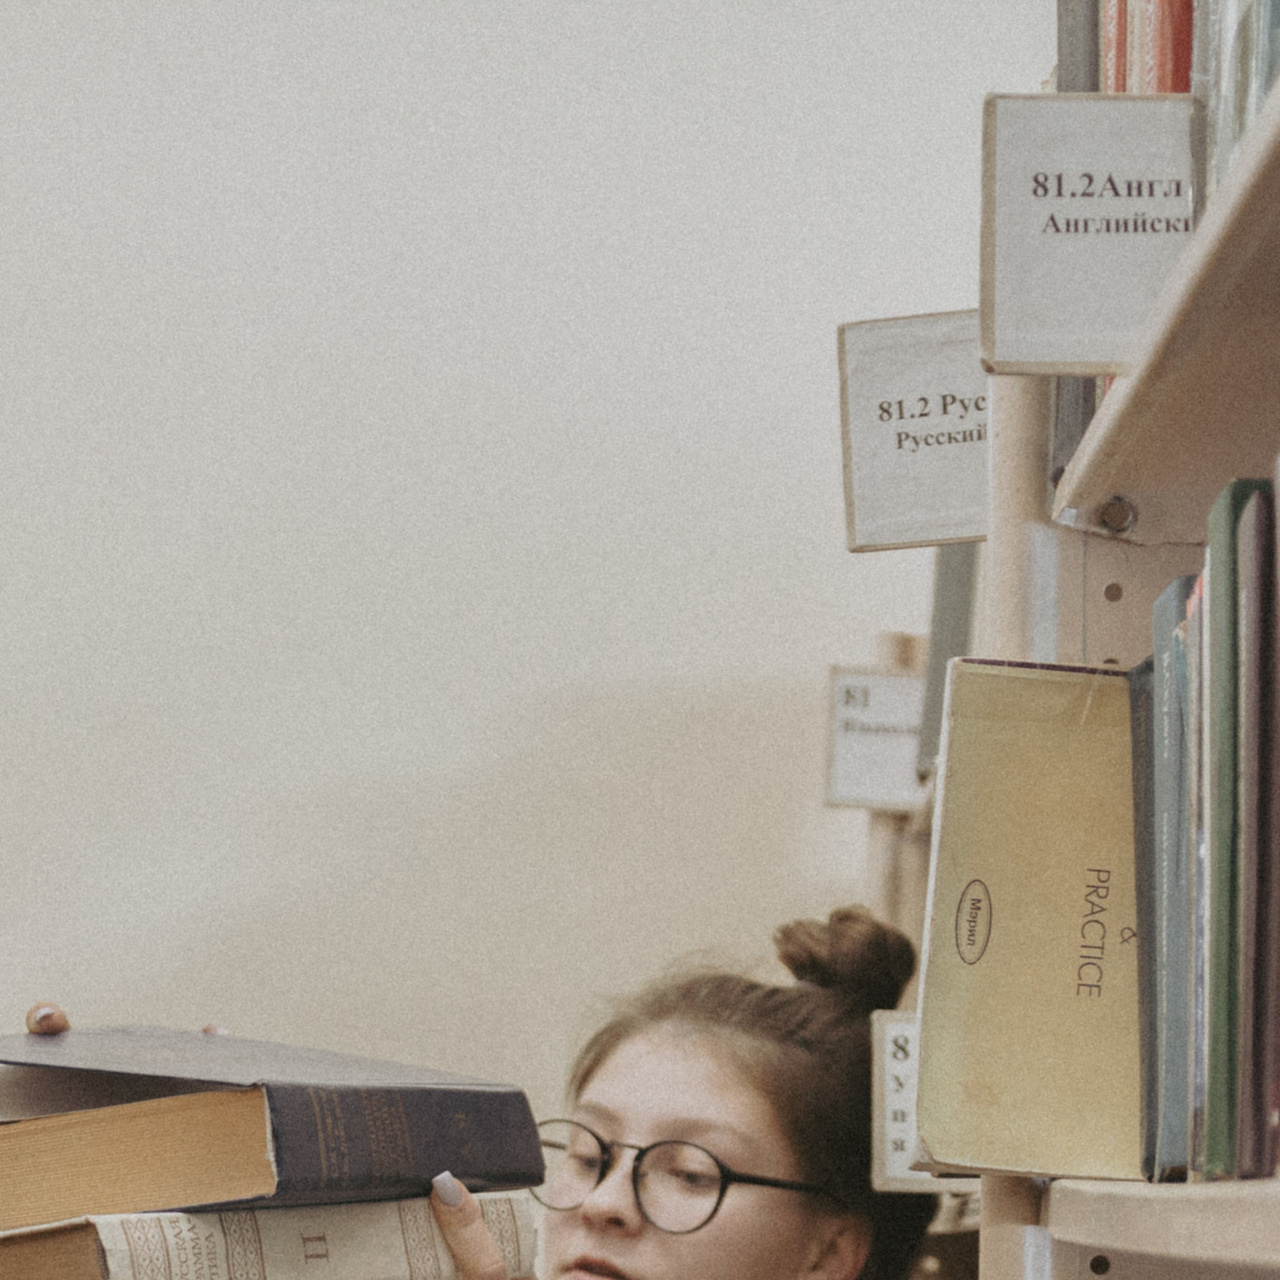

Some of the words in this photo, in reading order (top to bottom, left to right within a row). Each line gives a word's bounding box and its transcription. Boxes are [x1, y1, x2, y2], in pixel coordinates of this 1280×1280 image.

[1031, 171, 1184, 199] 81.2Англ
[878, 396, 931, 422] 81.2
[940, 393, 988, 420] Рус
[965, 897, 982, 946] Мэрил
[1076, 867, 1111, 998] PRACTICE
[205, 1231, 220, 1280] ТИКА
